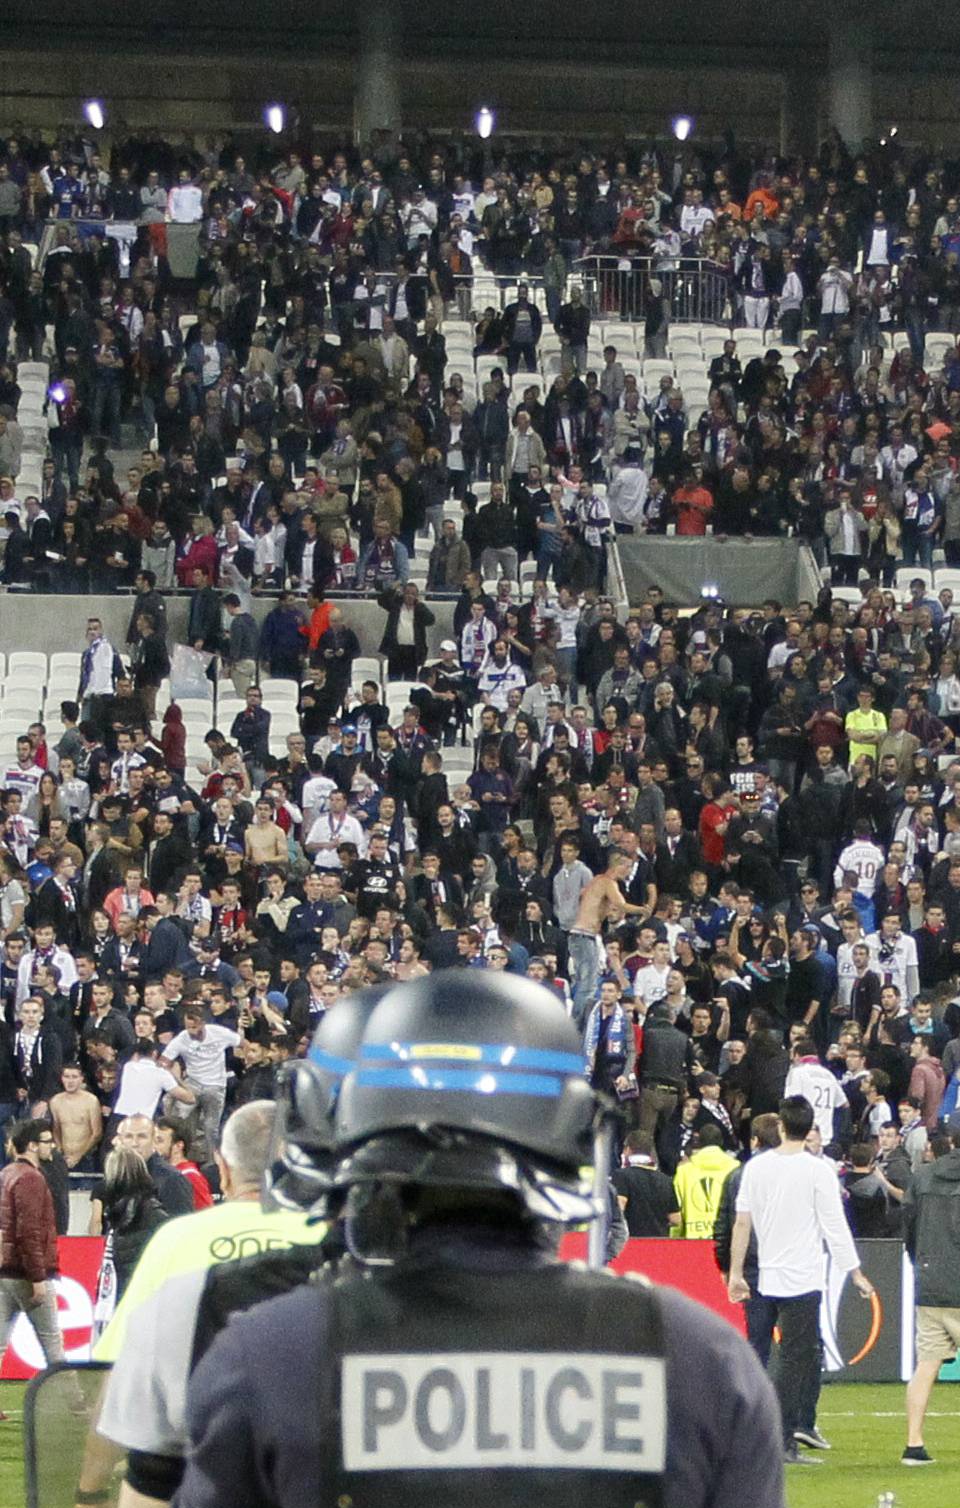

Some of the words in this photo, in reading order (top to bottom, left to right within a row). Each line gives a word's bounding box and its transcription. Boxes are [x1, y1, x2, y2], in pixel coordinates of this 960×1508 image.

[855, 862, 875, 880] 10
[814, 1086, 831, 1109] 21
[362, 1368, 644, 1453] POLICE
